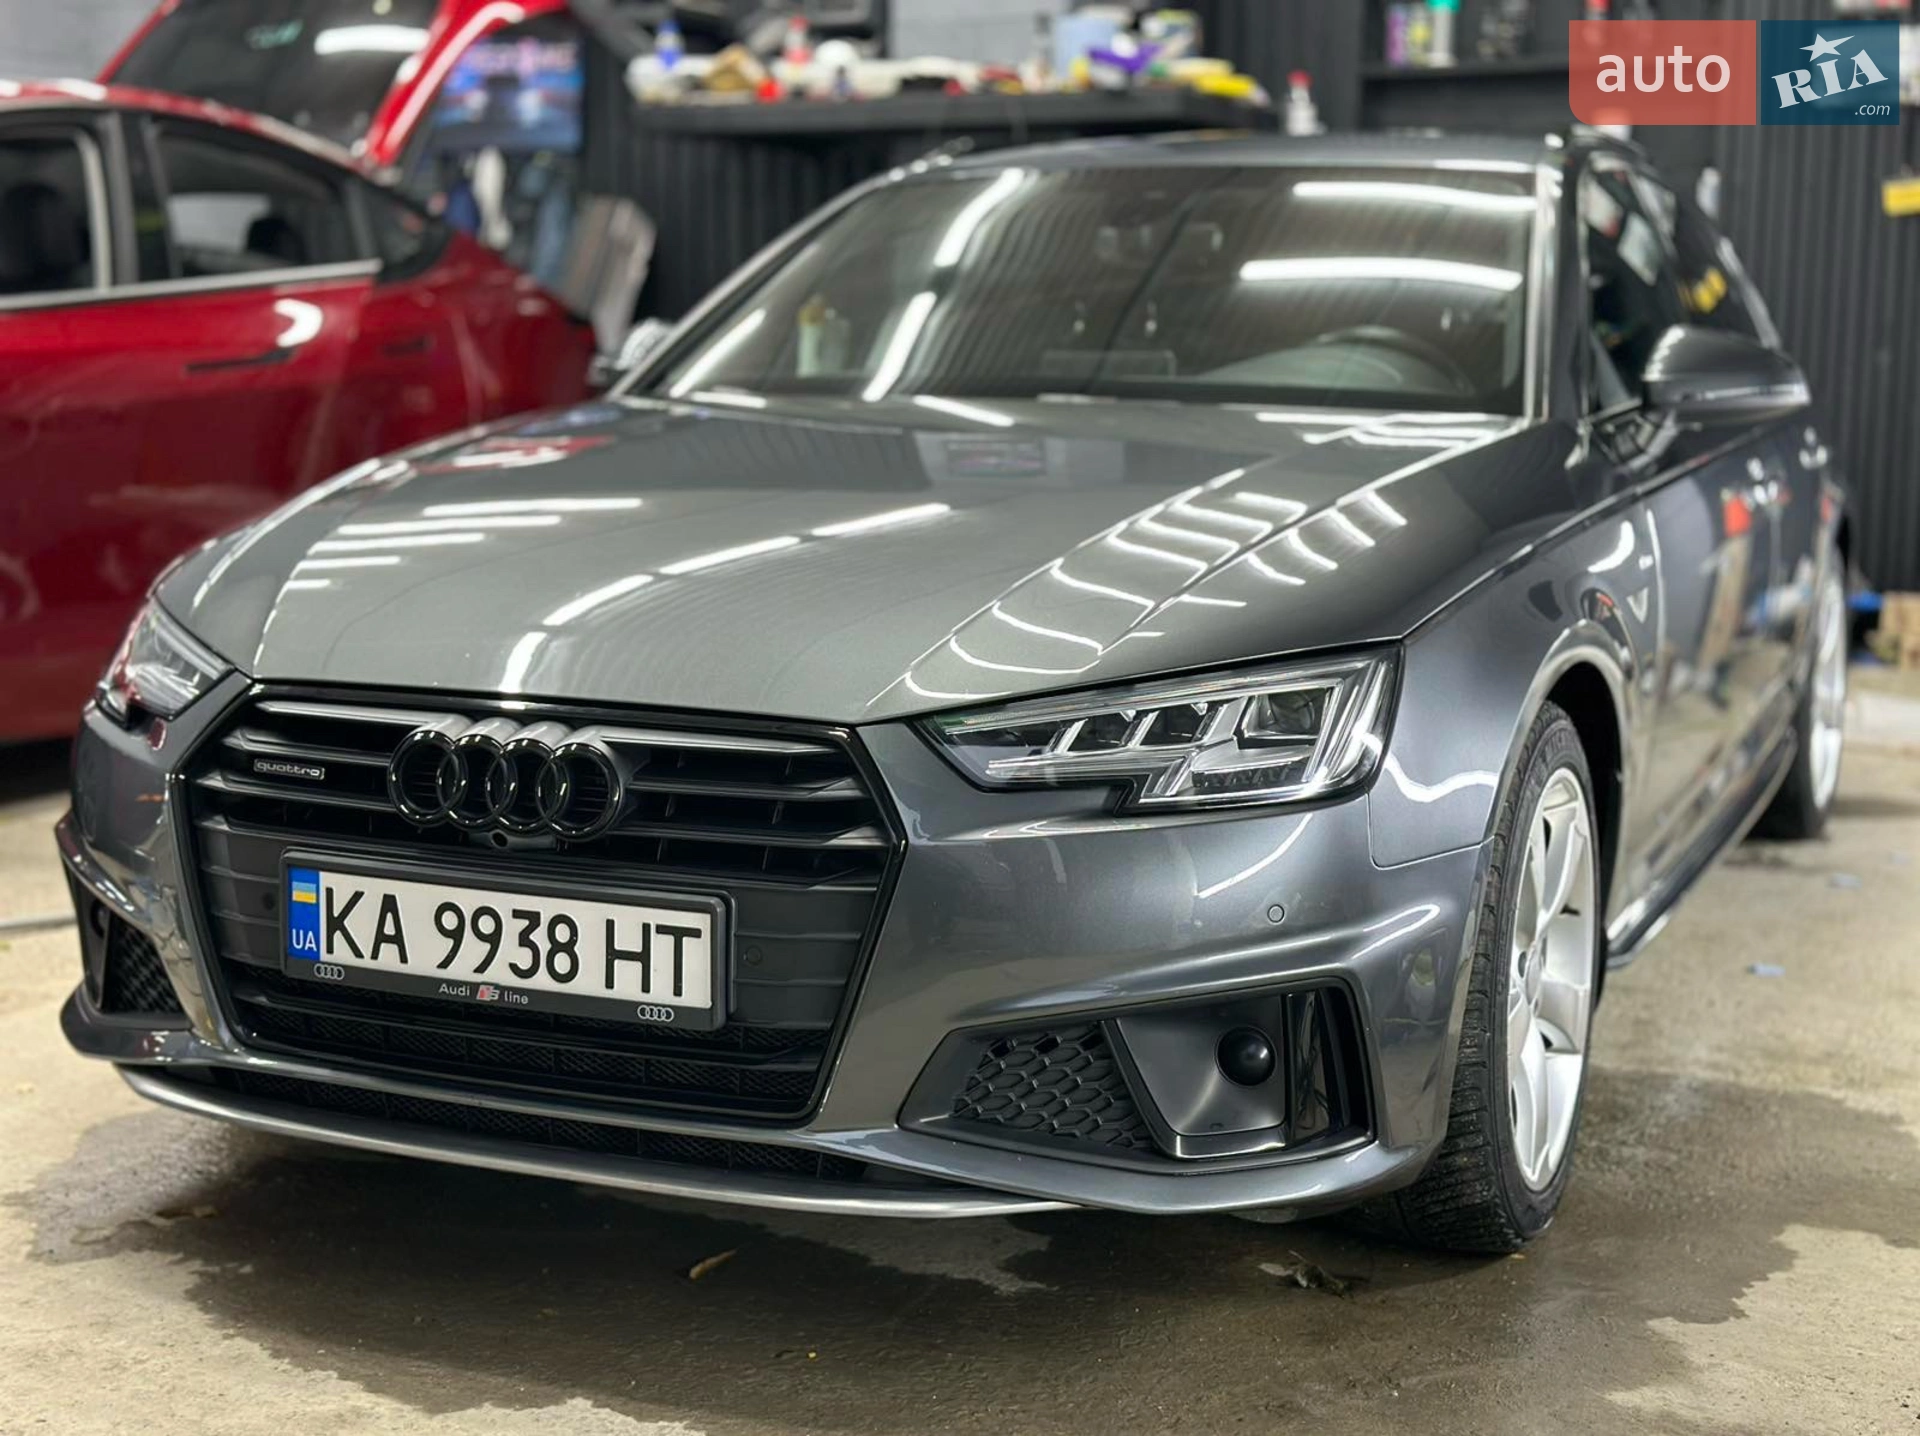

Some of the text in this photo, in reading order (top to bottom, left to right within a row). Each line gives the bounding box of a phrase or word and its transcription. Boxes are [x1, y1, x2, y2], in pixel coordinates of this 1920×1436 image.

[256, 761, 321, 777] quattro
[291, 928, 318, 952] UA
[325, 886, 702, 998] KA 9938 HT
[438, 983, 471, 997] Audi
[504, 991, 529, 1005] line
